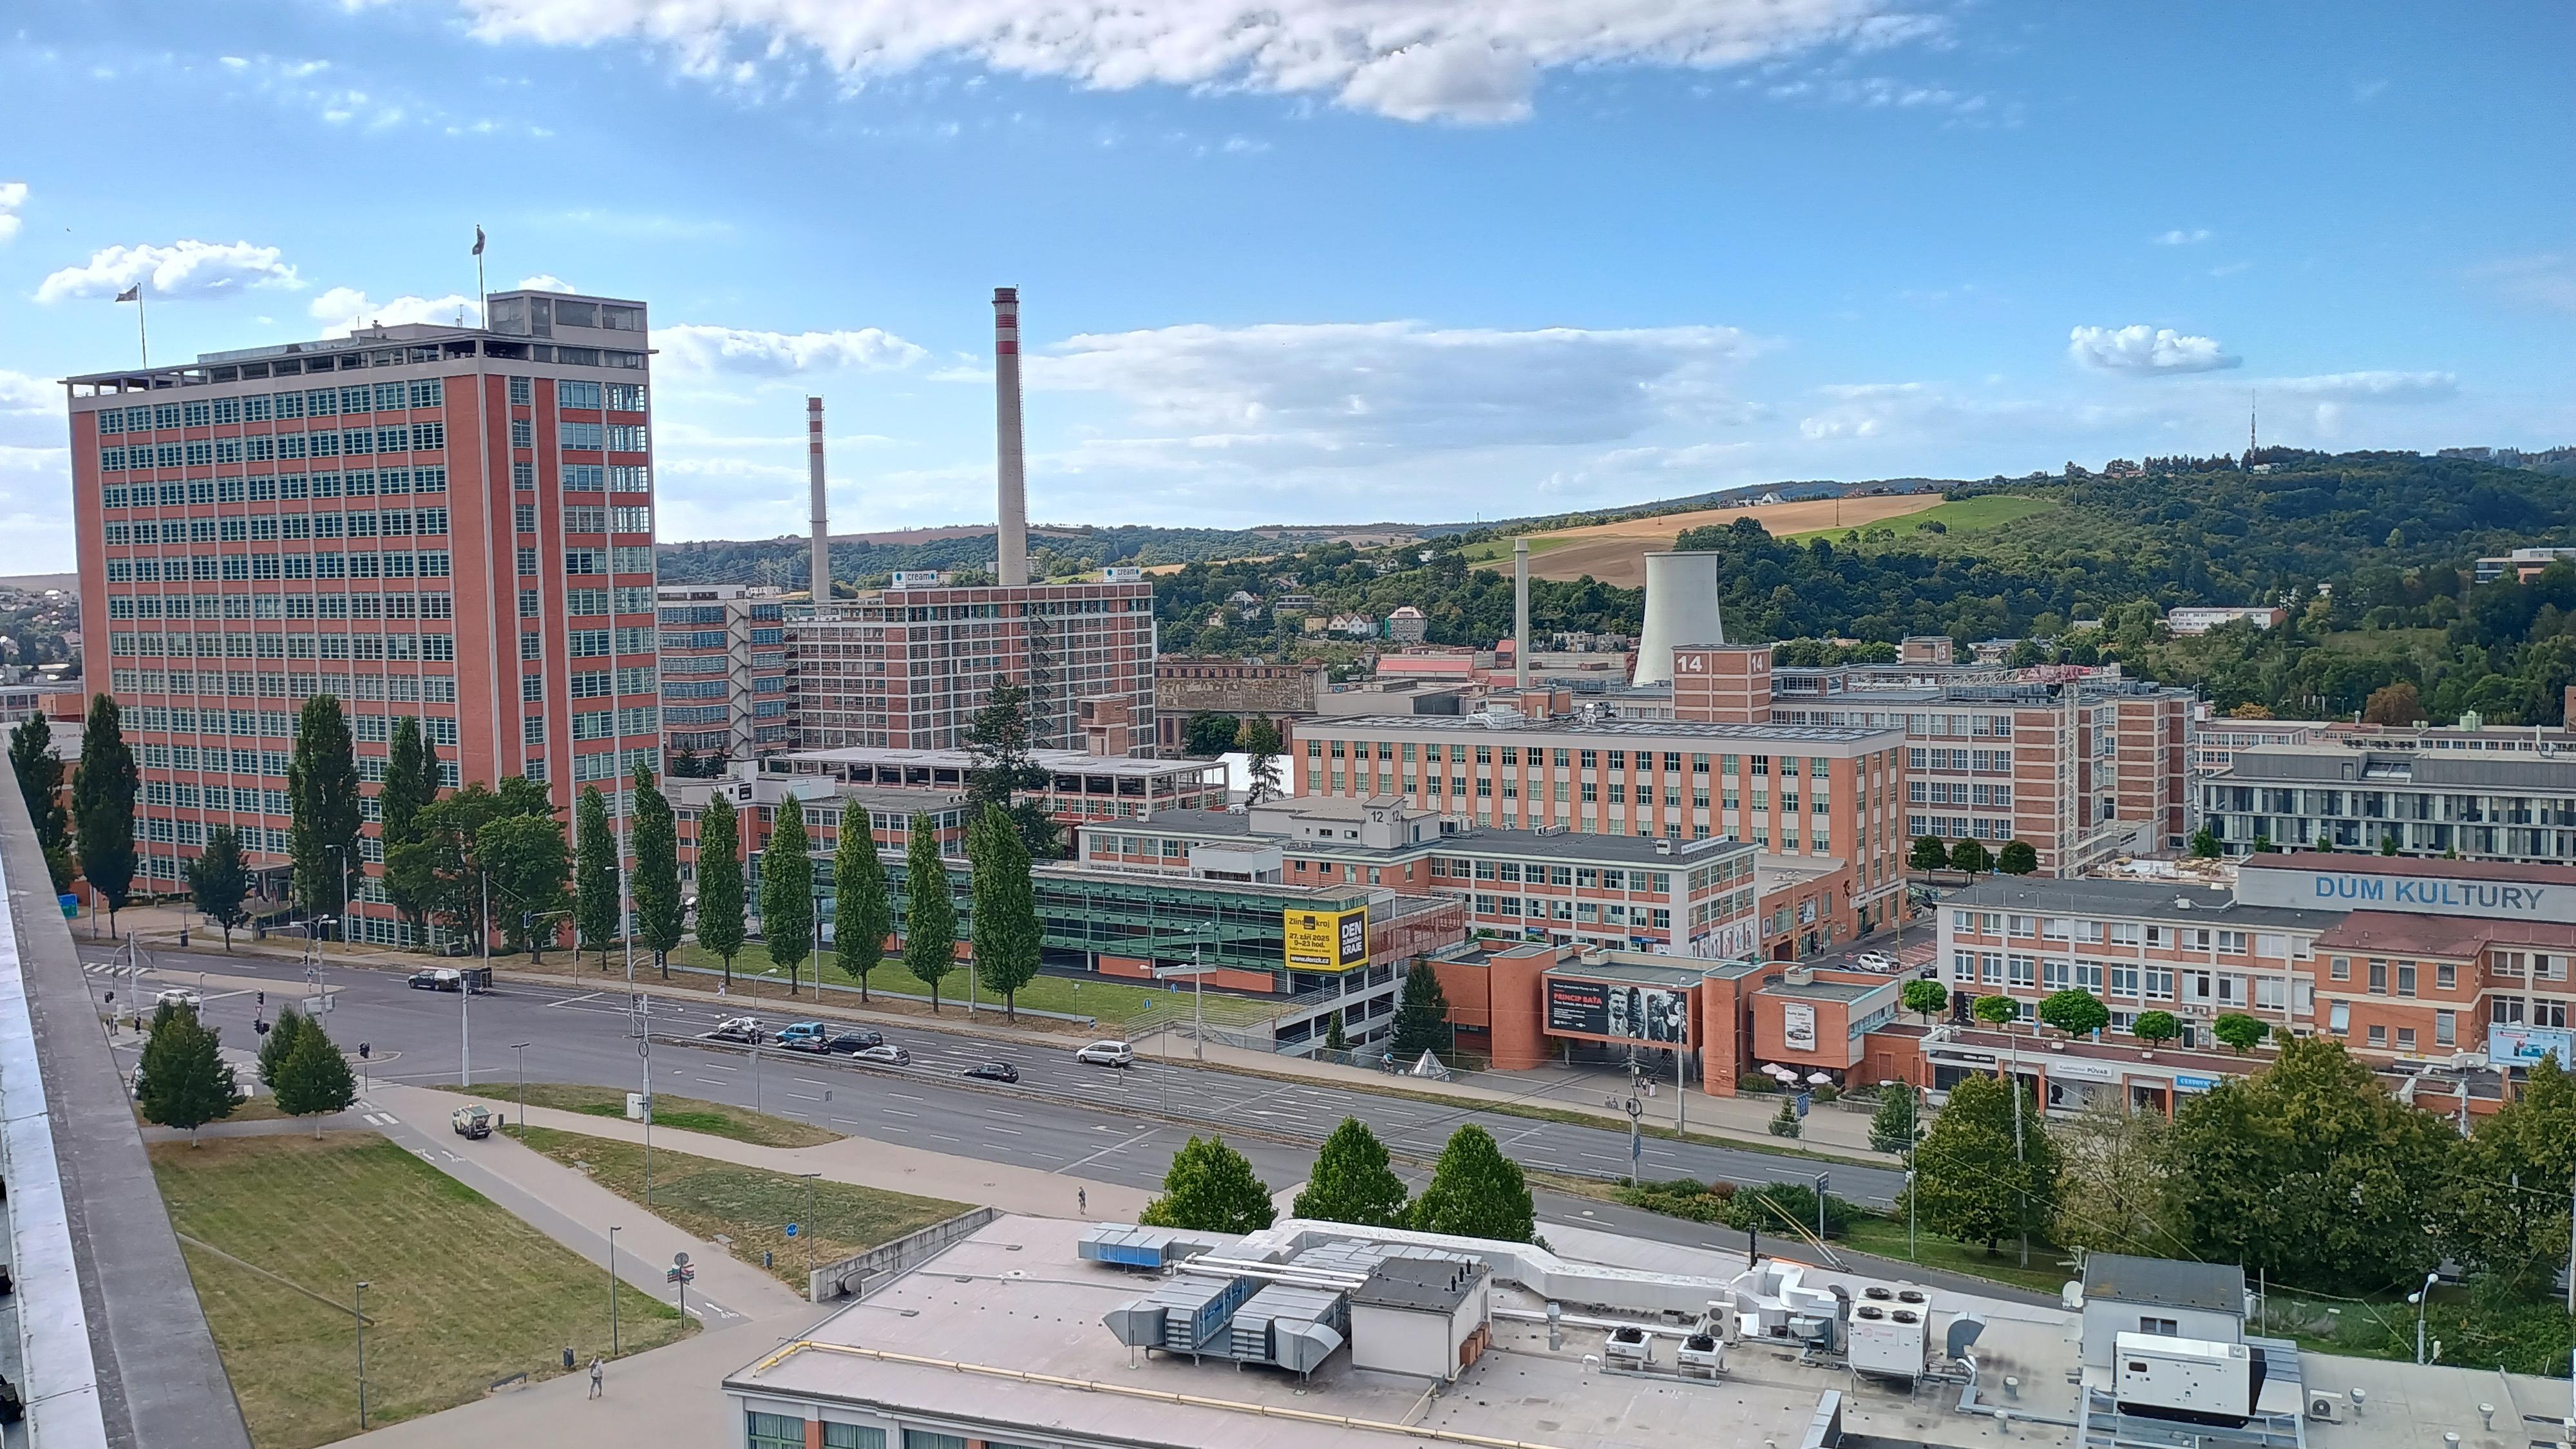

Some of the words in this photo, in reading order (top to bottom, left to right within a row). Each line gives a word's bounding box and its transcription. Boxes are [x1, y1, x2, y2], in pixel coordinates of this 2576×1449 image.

[1938, 645, 1946, 659] 15
[1677, 656, 1703, 672] 14
[1752, 654, 1763, 672] 14
[1371, 811, 1384, 823] 12
[1392, 810, 1399, 822] 12
[2395, 880, 2545, 911] KULTURY
[1342, 920, 1362, 939] DEN
[1342, 941, 1362, 956] KRAJE
[1553, 992, 1582, 1001] PRINCIP
[1582, 996, 1602, 1005] BAŤA
[2087, 1066, 2108, 1075] PŮVAB
